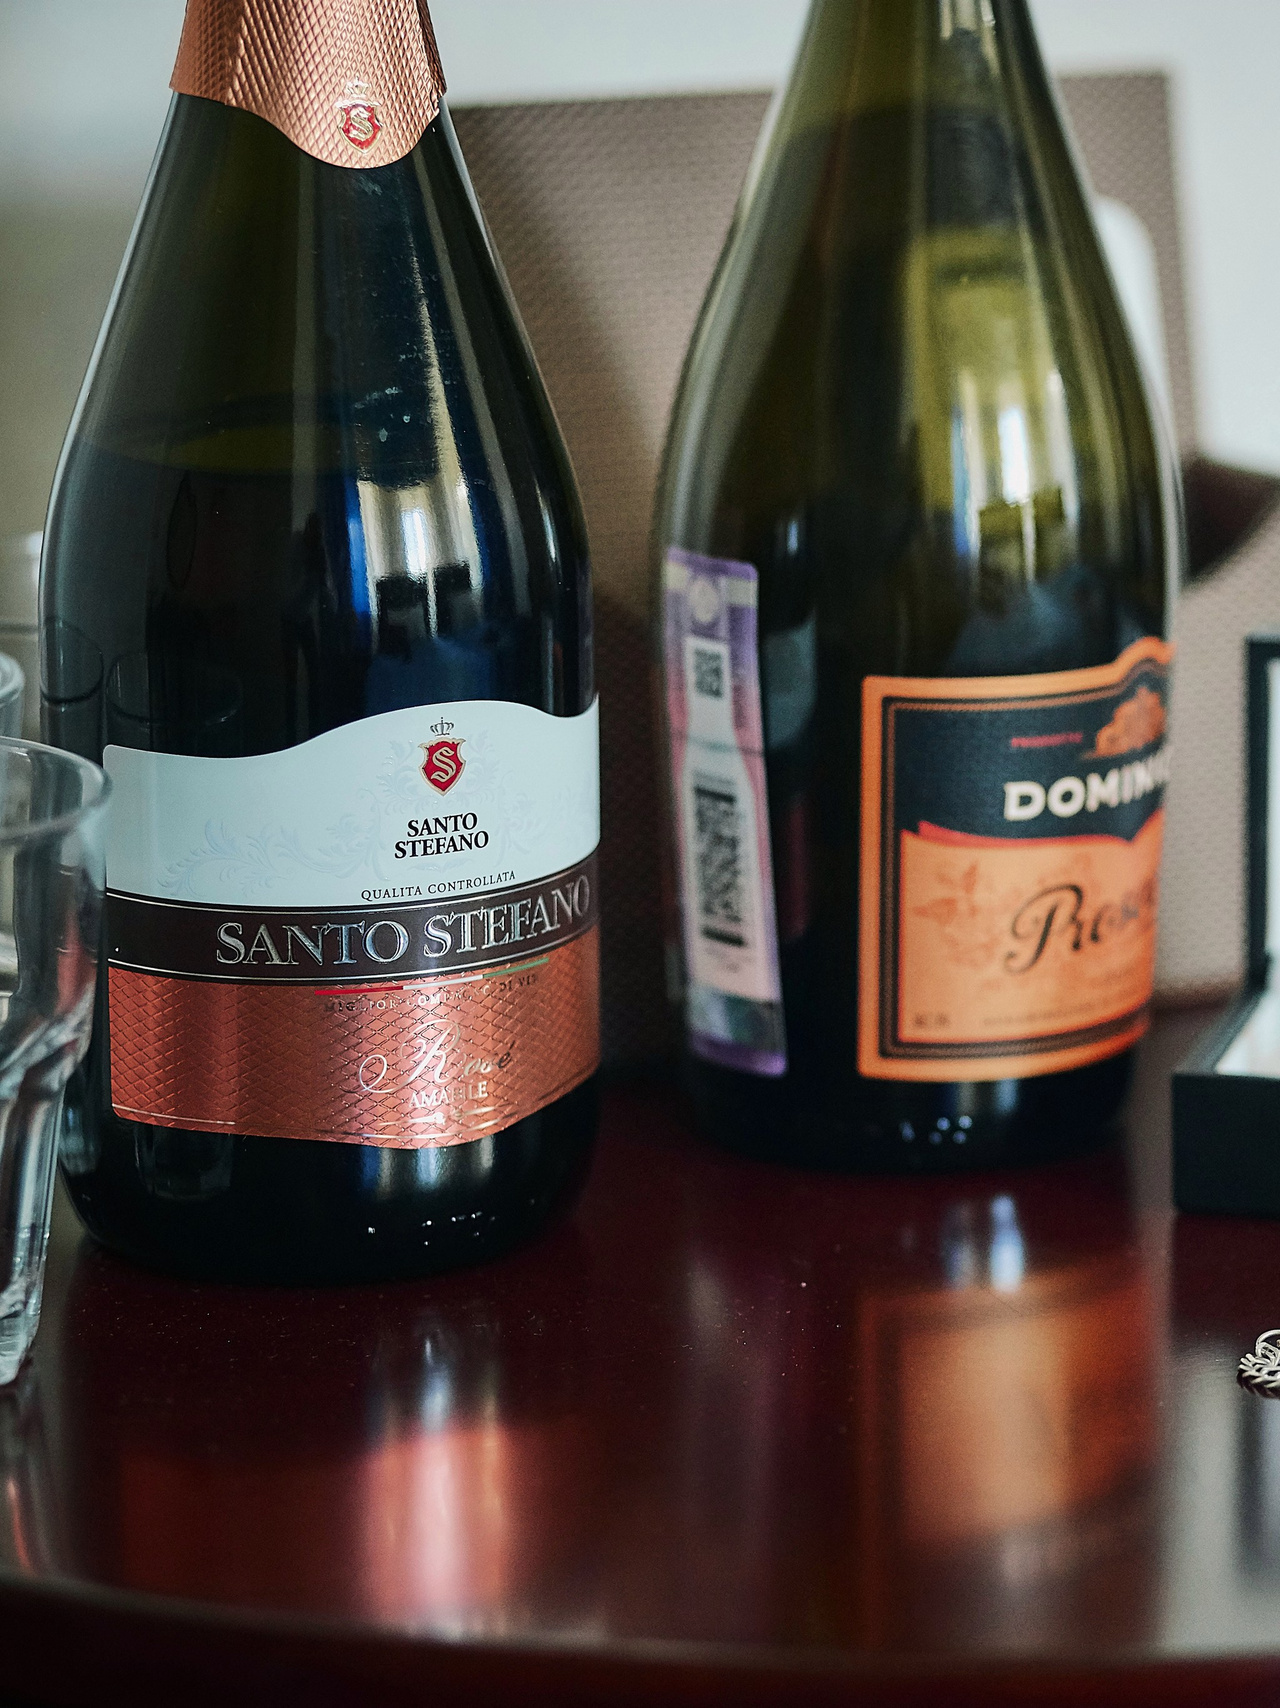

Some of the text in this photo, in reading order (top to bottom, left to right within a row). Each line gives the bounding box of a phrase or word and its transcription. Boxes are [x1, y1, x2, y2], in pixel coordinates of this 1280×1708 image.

[431, 746, 457, 783] S
[406, 812, 478, 838] SANTO
[394, 830, 489, 859] STEFANO
[361, 870, 516, 901] QUALITA CONTROLLATA
[215, 873, 590, 966] SANTO STEFANO
[408, 1080, 490, 1109] AMABILE
